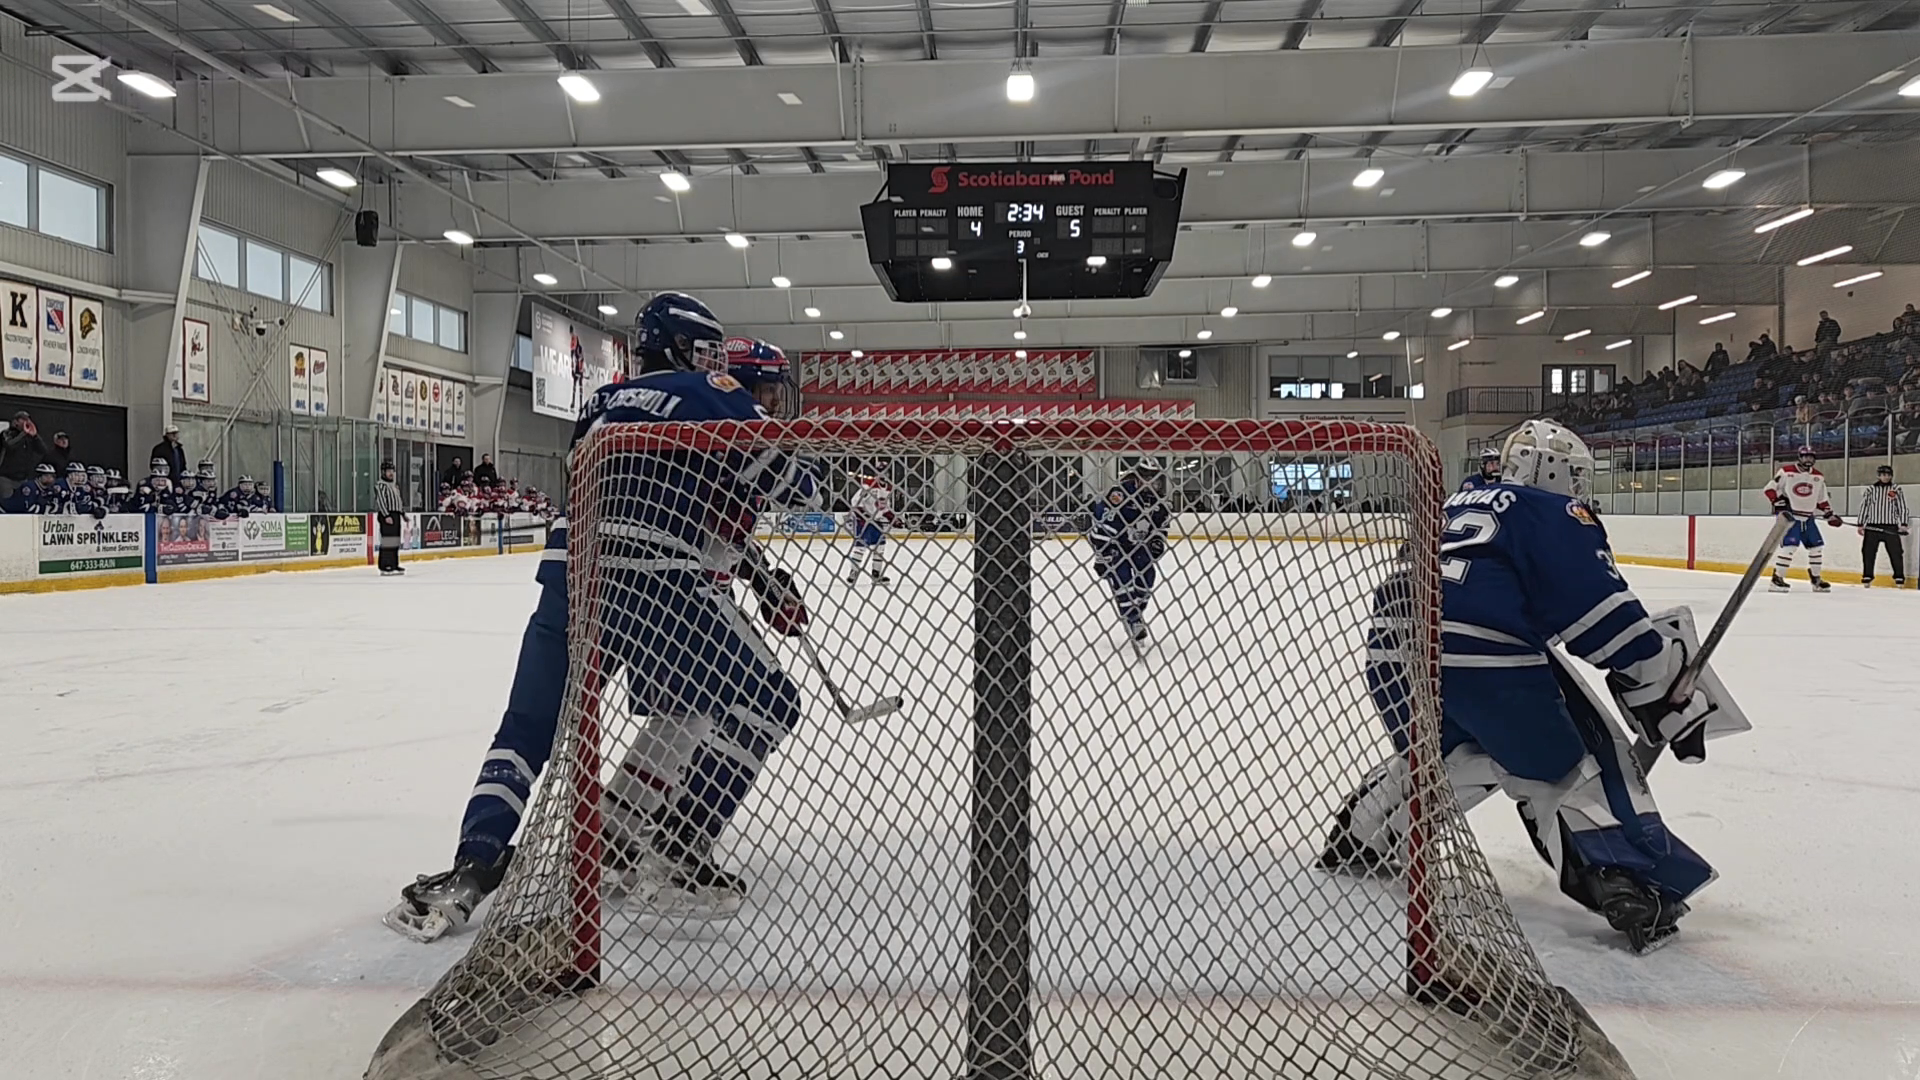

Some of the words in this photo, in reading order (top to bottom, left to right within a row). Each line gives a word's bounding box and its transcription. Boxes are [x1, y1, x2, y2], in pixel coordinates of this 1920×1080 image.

[958, 170, 1064, 187] Scotiabank
[1069, 169, 1115, 185] Pond
[894, 209, 917, 217] PLAYER
[920, 209, 947, 217] PENALTY
[957, 206, 983, 217] HOME
[1007, 203, 1044, 222] 2:34
[1055, 205, 1084, 216] GUEST
[1094, 207, 1121, 216] PENALTY
[1124, 207, 1148, 215] PLAYER
[970, 221, 981, 237] 4
[1008, 230, 1031, 238] PERIOD
[1070, 219, 1080, 237] 5
[1016, 240, 1025, 254] 3
[9, 291, 28, 328] K
[43, 521, 75, 533] Urban
[261, 521, 282, 532] SOMA
[43, 534, 74, 546] LAWN
[77, 531, 140, 545] SPRINKLERS
[1440, 508, 1500, 585] 2
[70, 559, 116, 571] 647-333-RAIN
